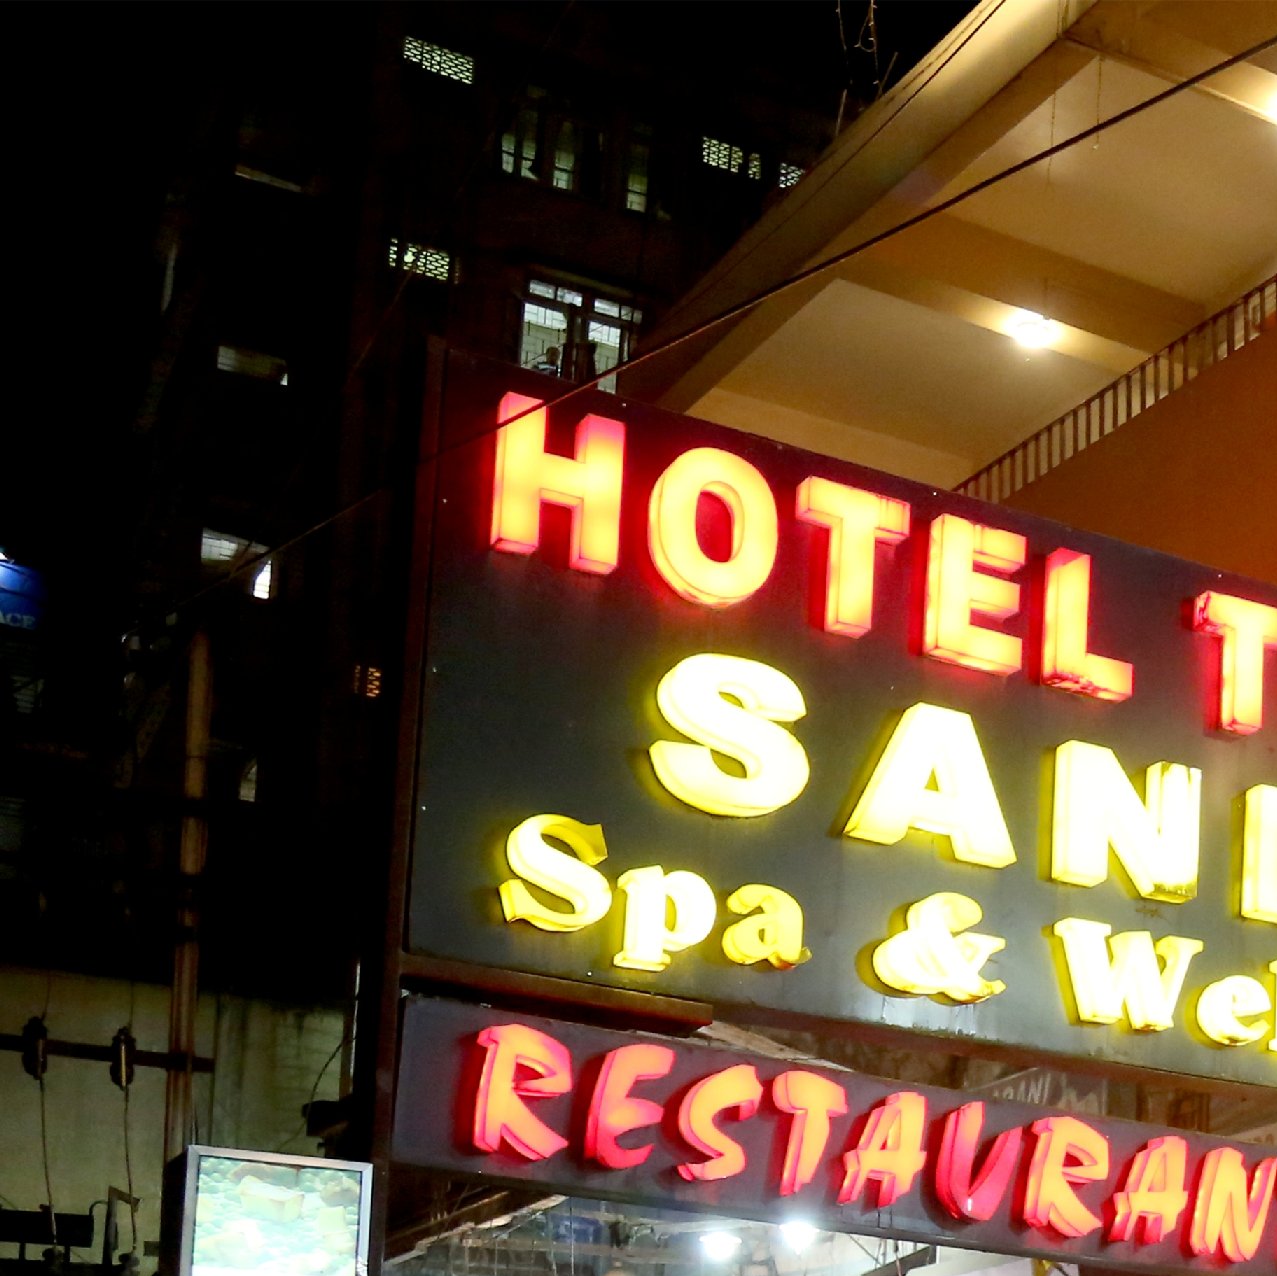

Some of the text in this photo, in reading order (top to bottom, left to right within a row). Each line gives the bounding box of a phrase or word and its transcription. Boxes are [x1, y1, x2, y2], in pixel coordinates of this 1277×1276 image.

[488, 390, 1135, 704] HOTEL
[498, 812, 812, 972] Spa
[872, 891, 1008, 1004] &
